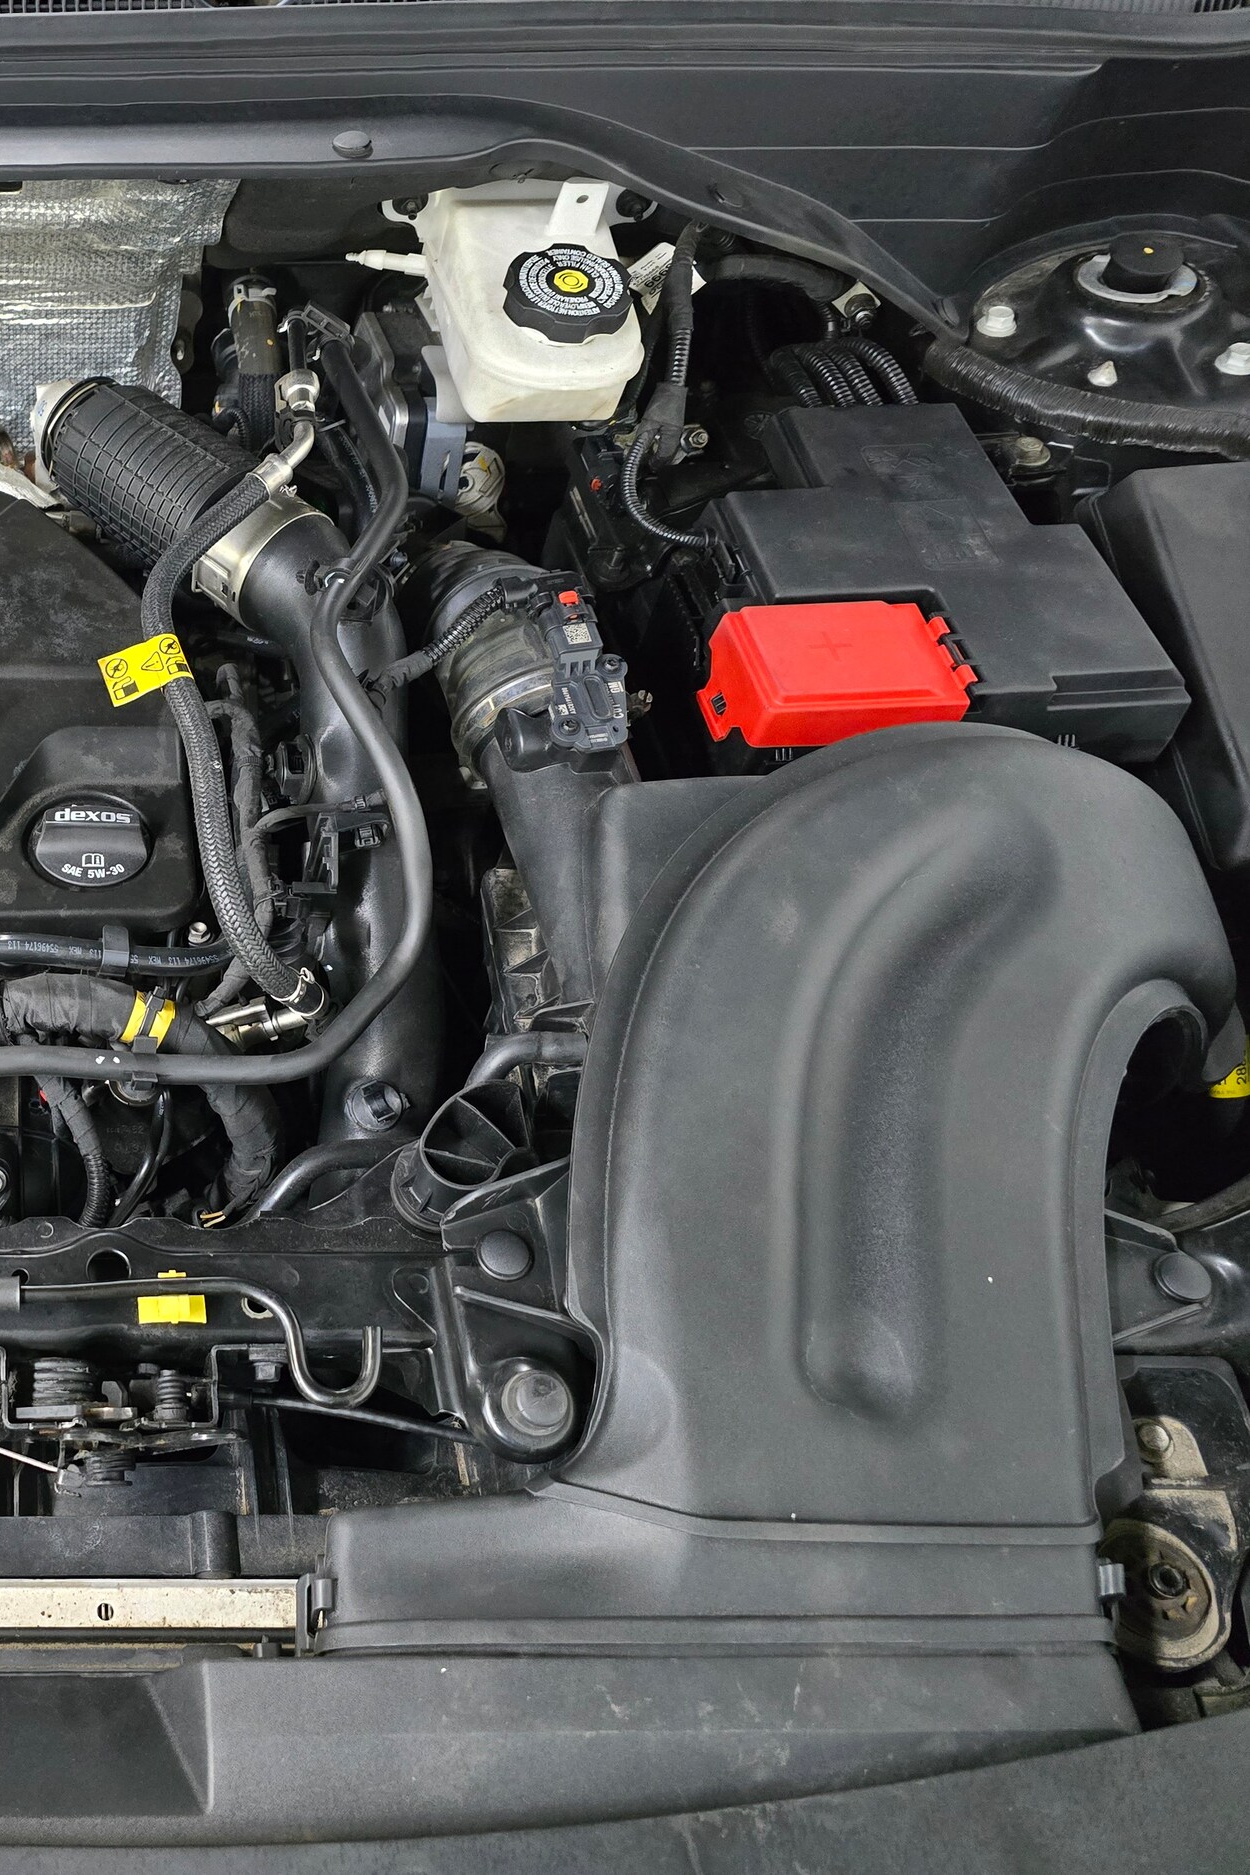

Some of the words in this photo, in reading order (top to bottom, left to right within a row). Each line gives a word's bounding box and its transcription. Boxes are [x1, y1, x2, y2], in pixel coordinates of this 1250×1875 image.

[54, 808, 132, 823] dexos
[61, 863, 83, 877] SAE
[87, 863, 125, 878] 5W-30
[7, 940, 21, 950] 113
[24, 940, 59, 954] 55496174
[68, 945, 82, 955] MEX
[148, 955, 162, 965] MEX
[168, 955, 181, 965] 113
[184, 954, 220, 965] 55496174
